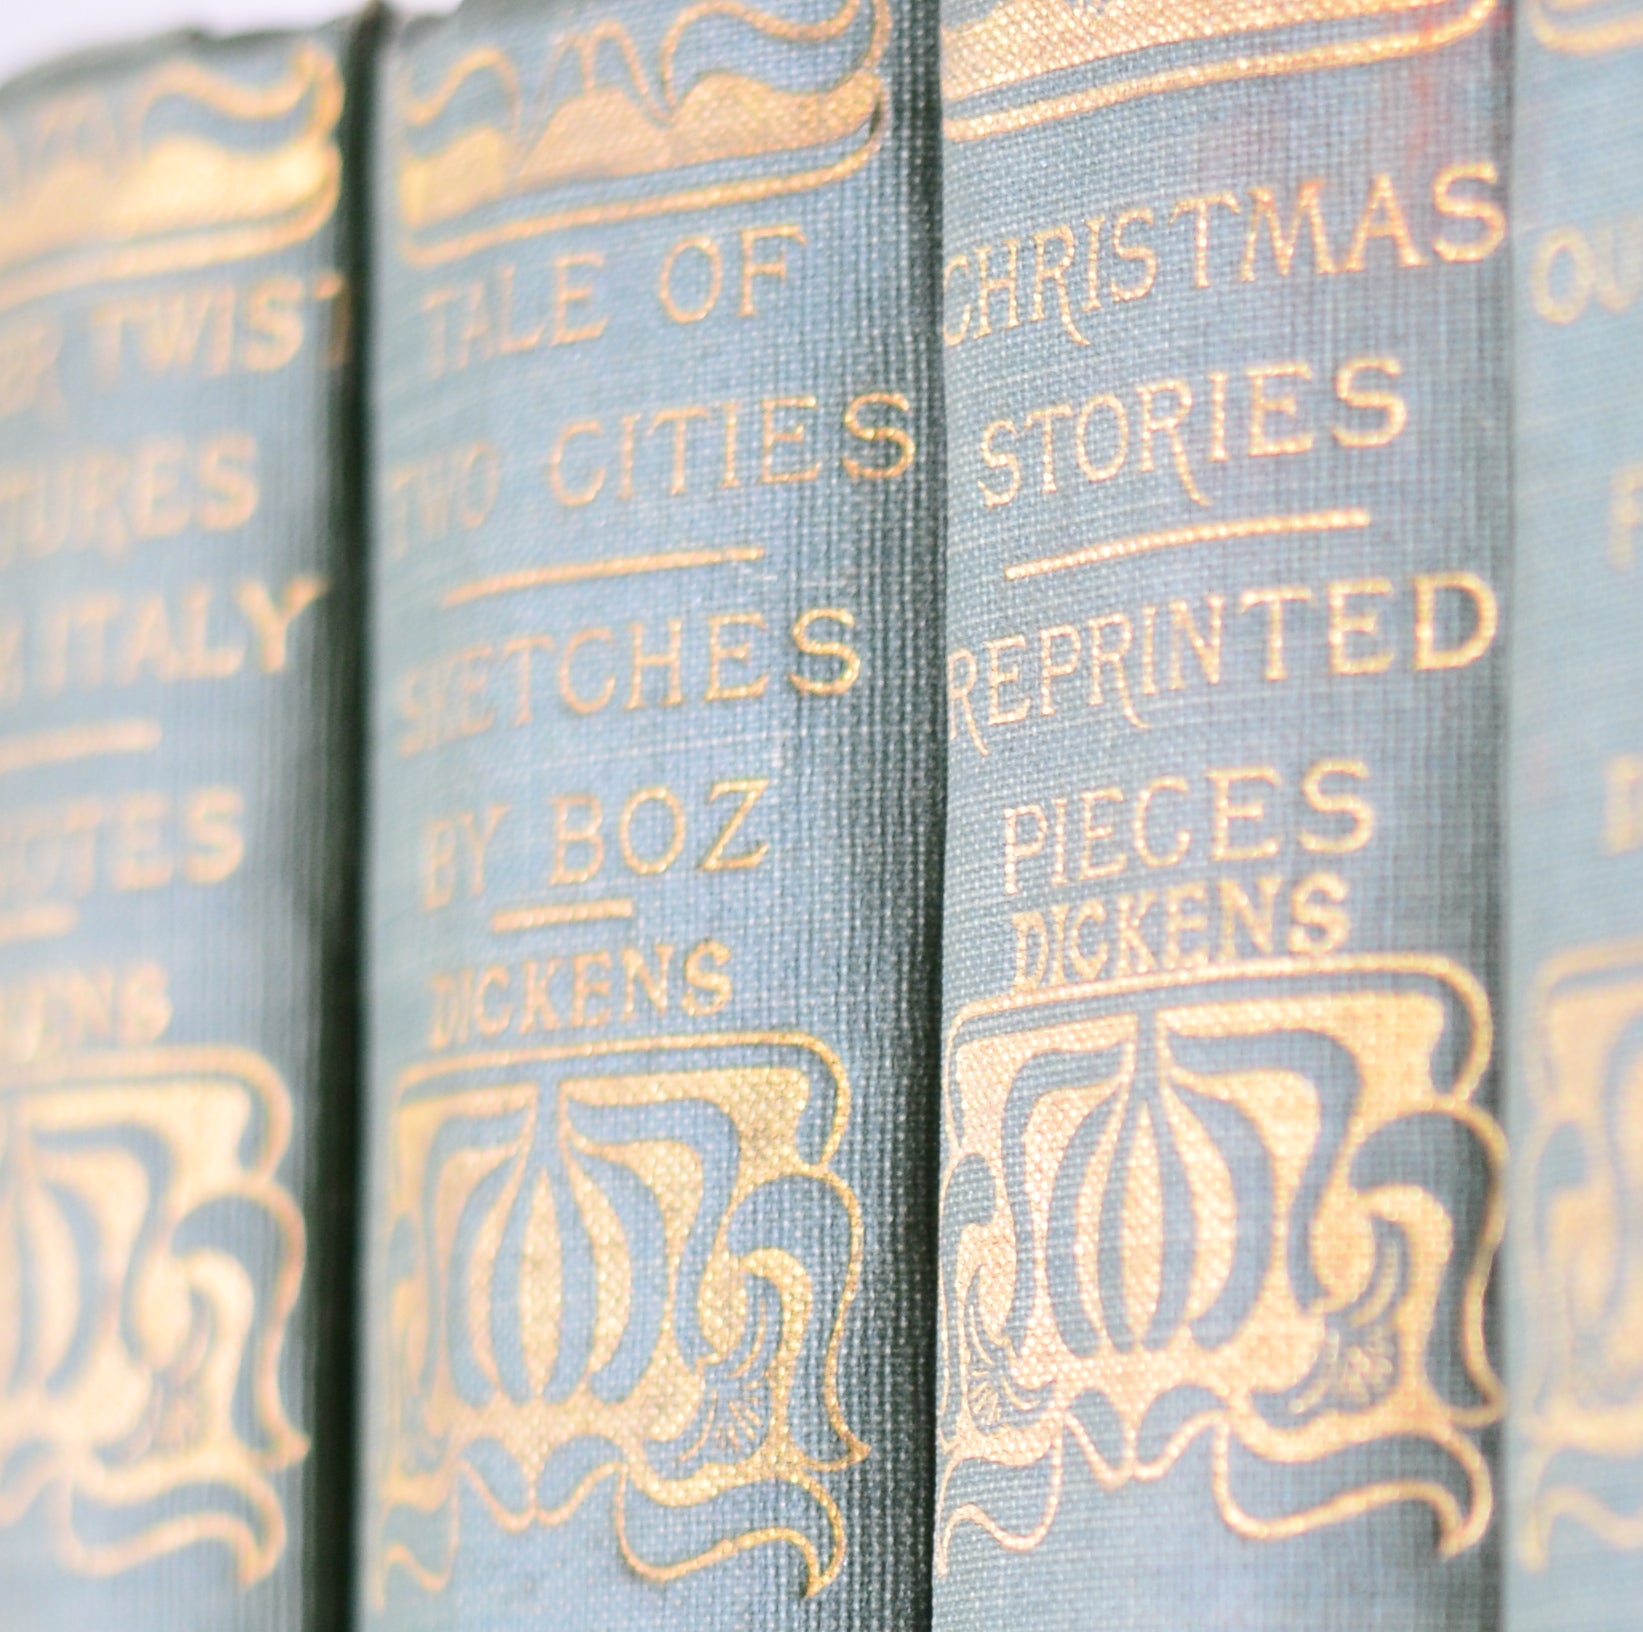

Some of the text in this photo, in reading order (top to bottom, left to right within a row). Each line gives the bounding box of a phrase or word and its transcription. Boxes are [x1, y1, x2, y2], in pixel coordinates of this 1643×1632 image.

[420, 223, 809, 380] TALE OF
[943, 161, 1507, 347] CHRISTMAS
[549, 392, 917, 508] CITIES
[977, 356, 1408, 508] STORIES
[38, 574, 332, 698] ITALY
[947, 570, 1499, 757] REPRINTED
[420, 777, 770, 910] BY BOZ
[1002, 757, 1376, 895] PIECES
[426, 938, 735, 1053] DICKENS
[1010, 870, 1352, 997] DICKENS
